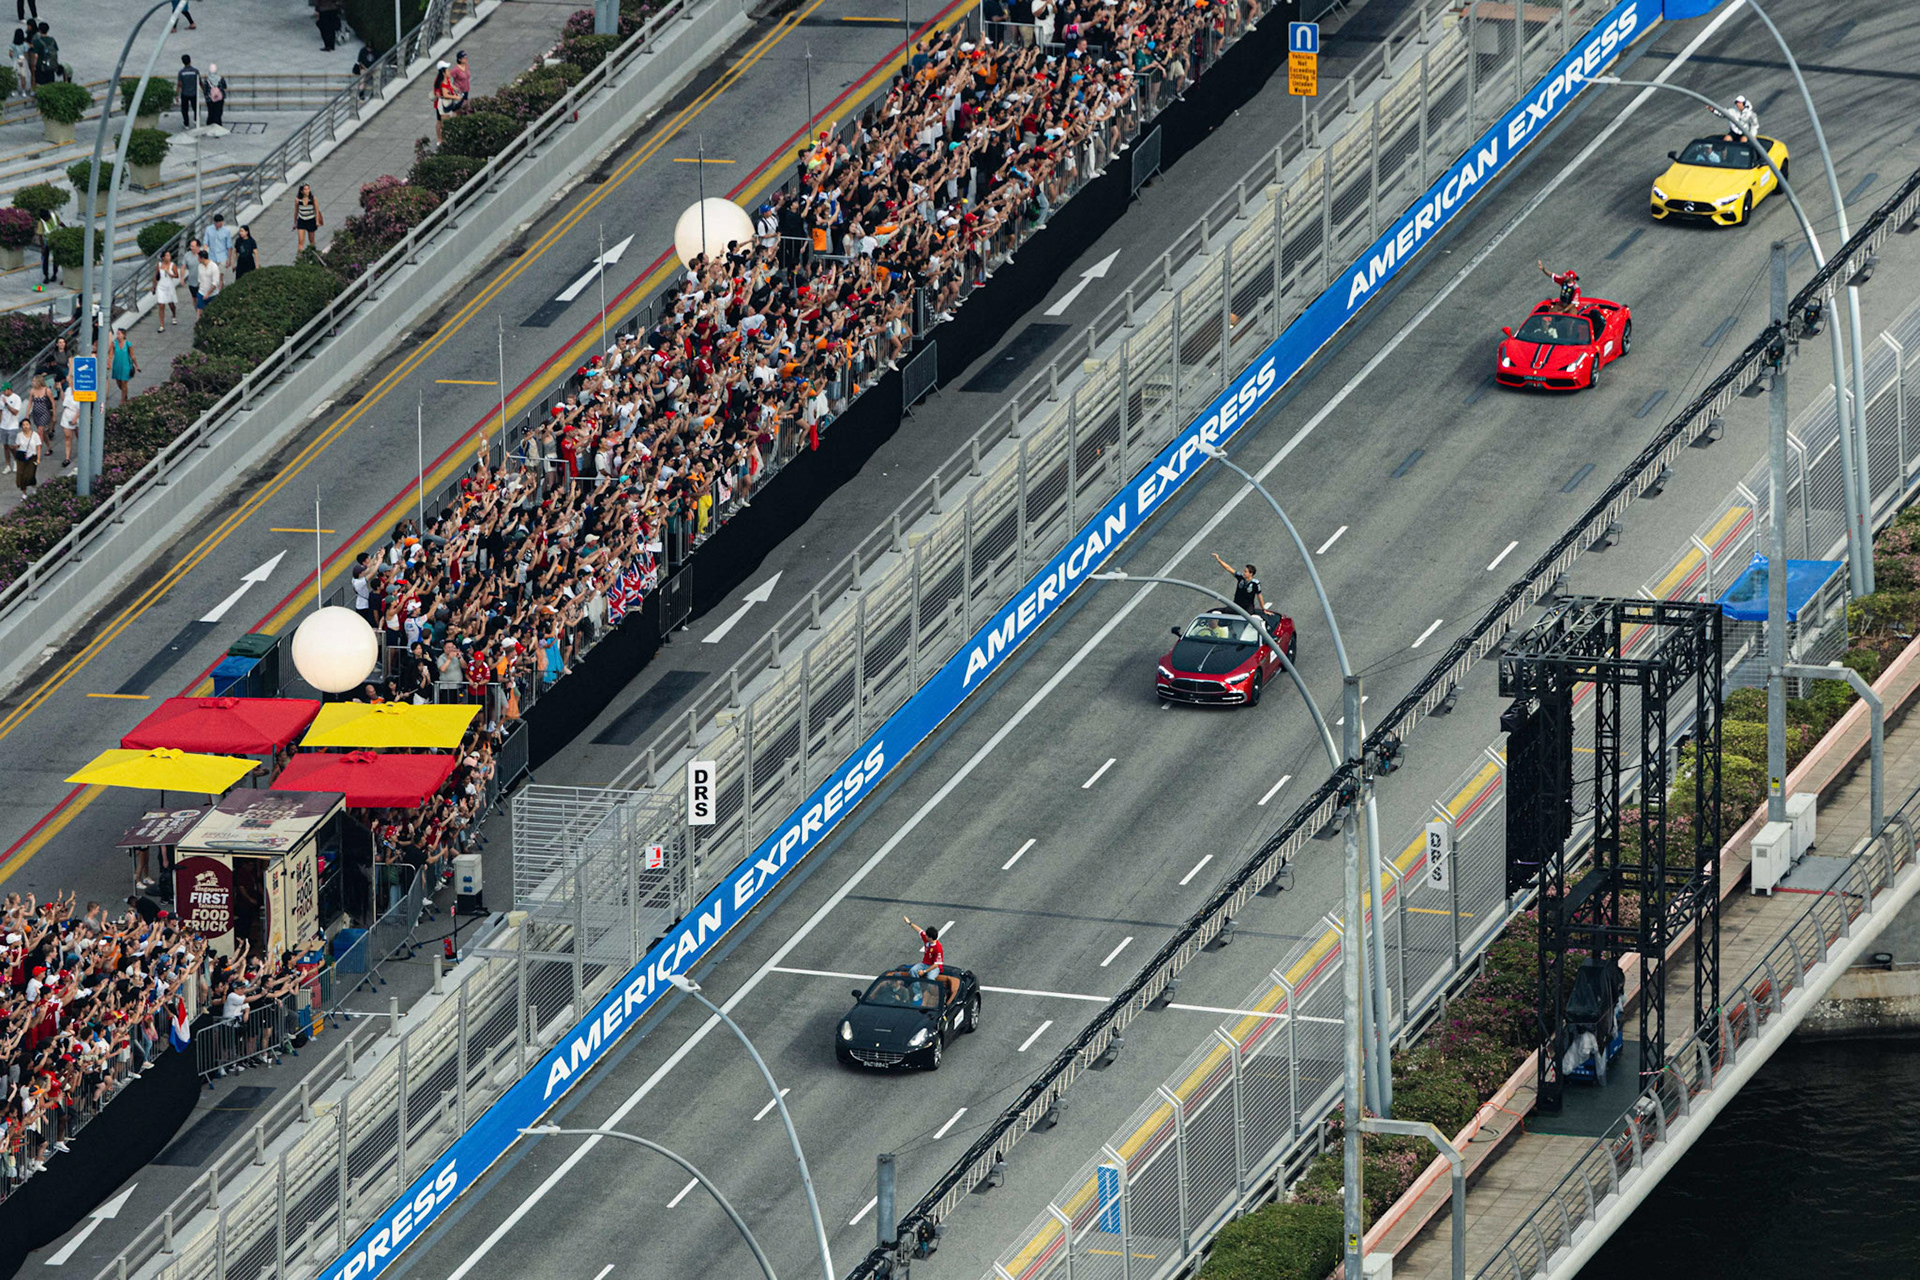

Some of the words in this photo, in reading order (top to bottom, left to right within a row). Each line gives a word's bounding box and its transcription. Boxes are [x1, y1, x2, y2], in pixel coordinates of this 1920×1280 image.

[1347, 137, 1498, 309] AMERICAN
[1508, 3, 1638, 149] EXPRESS
[963, 503, 1126, 687] AMERICAN
[1138, 357, 1276, 515] EXPRESS
[694, 769, 709, 817] DRS
[1430, 832, 1442, 881] DRS
[189, 892, 229, 904] FIRST
[191, 909, 230, 920] FOOD
[543, 899, 722, 1100] AMERICAN
[735, 741, 885, 910] EXPRESS
[183, 920, 228, 932] TRUCK
